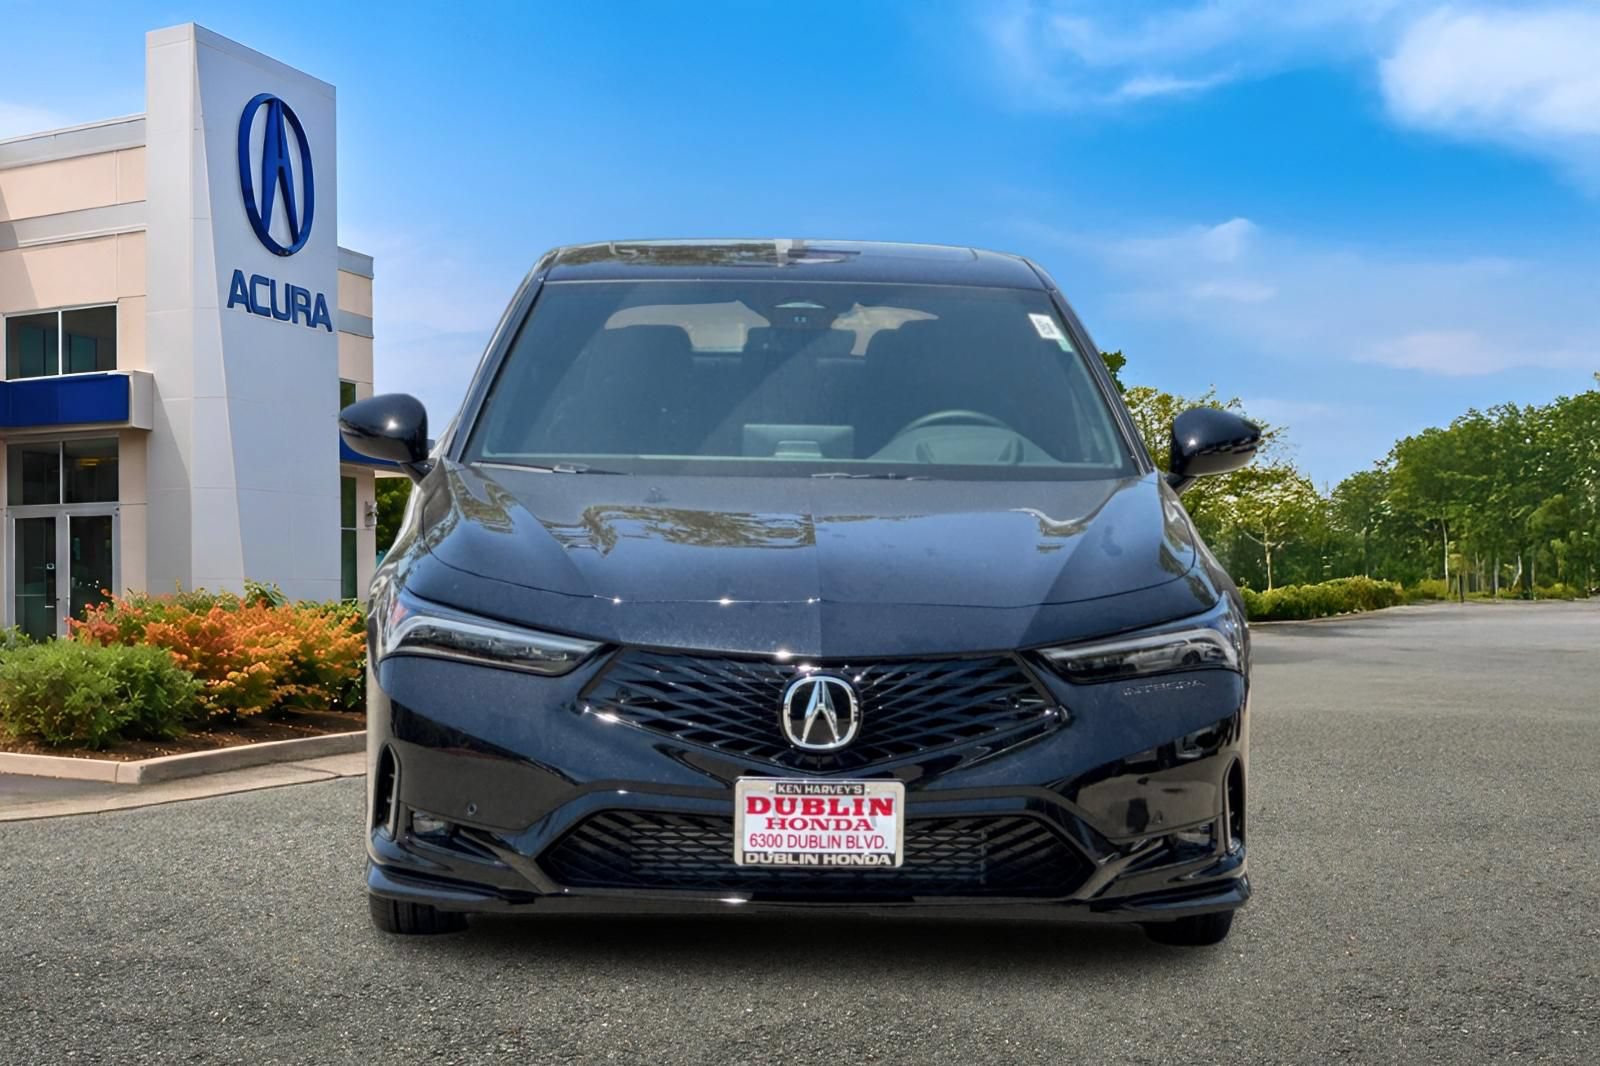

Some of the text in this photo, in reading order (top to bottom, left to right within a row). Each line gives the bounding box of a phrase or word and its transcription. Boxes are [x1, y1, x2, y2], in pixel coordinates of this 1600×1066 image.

[227, 269, 332, 332] ACURA
[777, 784, 863, 794] KEN HARVEY'S
[746, 796, 894, 816] DUBLIN
[765, 817, 874, 831] HONDA
[750, 833, 889, 849] 6300 DUBLIN BLVD.
[745, 852, 892, 865] DUBLIN HONDA
